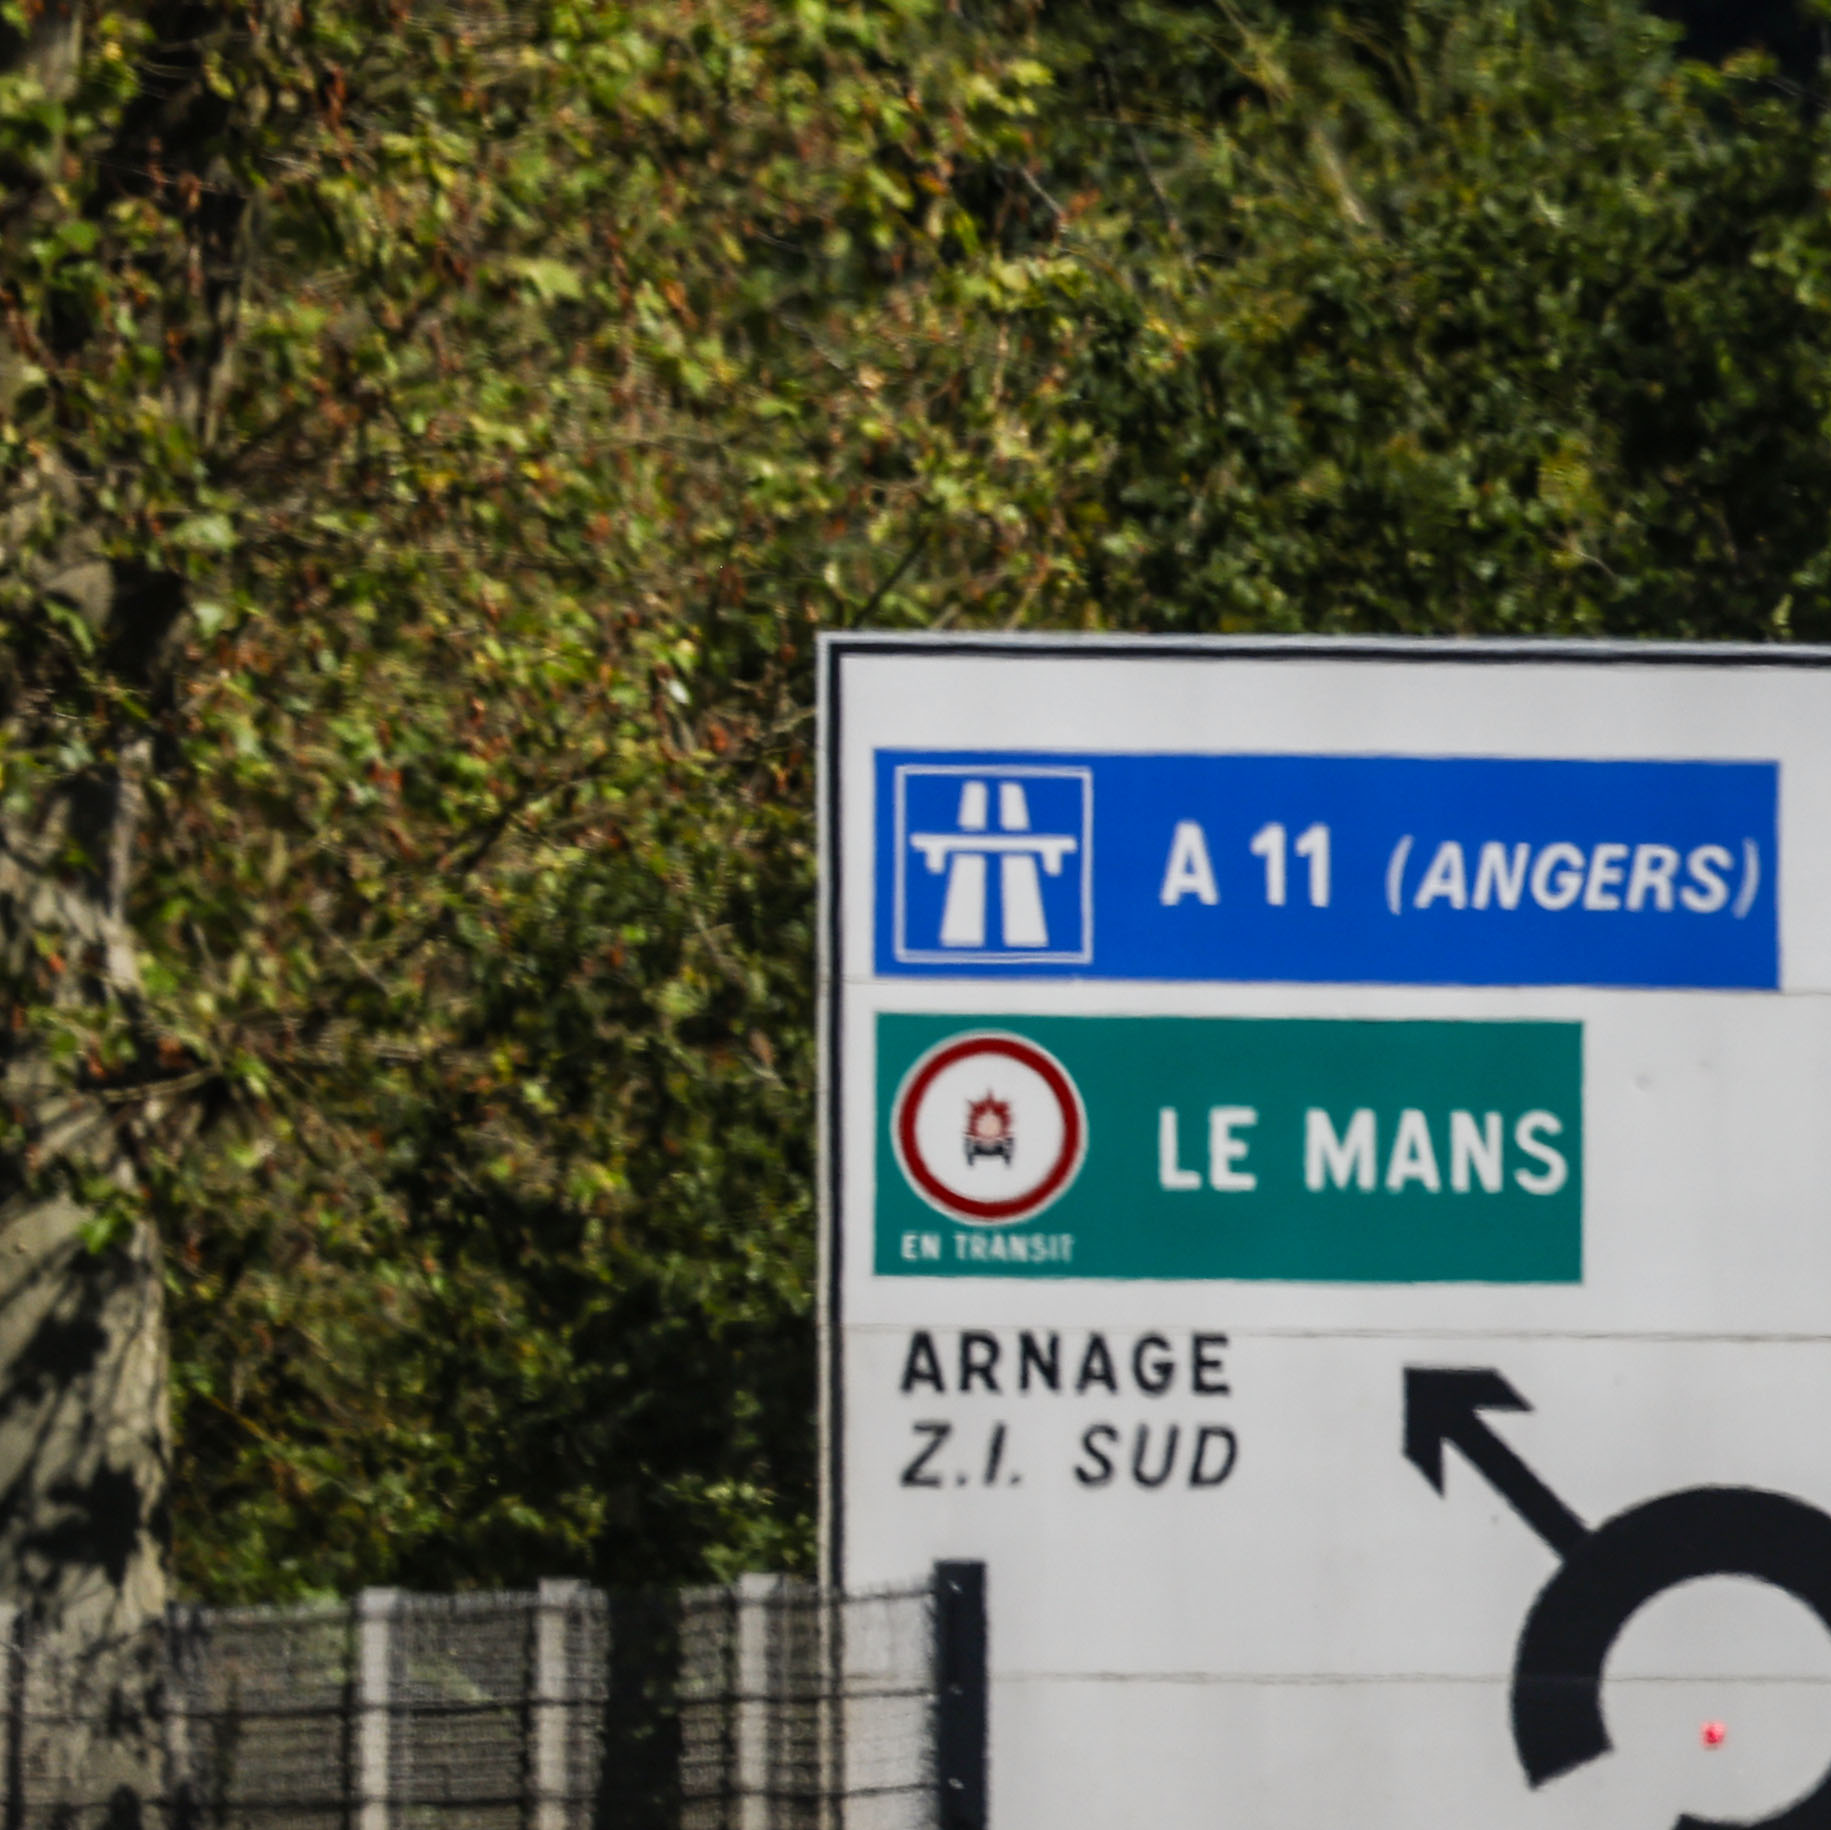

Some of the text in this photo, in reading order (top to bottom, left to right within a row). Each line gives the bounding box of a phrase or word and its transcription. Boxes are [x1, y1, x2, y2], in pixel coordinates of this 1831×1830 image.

[1160, 821, 1759, 916] A 11 (ANGERS)
[1158, 1106, 1568, 1196] LE MANS
[901, 1232, 1073, 1264] EN TRANSIT
[899, 1329, 1231, 1397] ARNAGE
[899, 1421, 1239, 1490] Z.I. SUD
